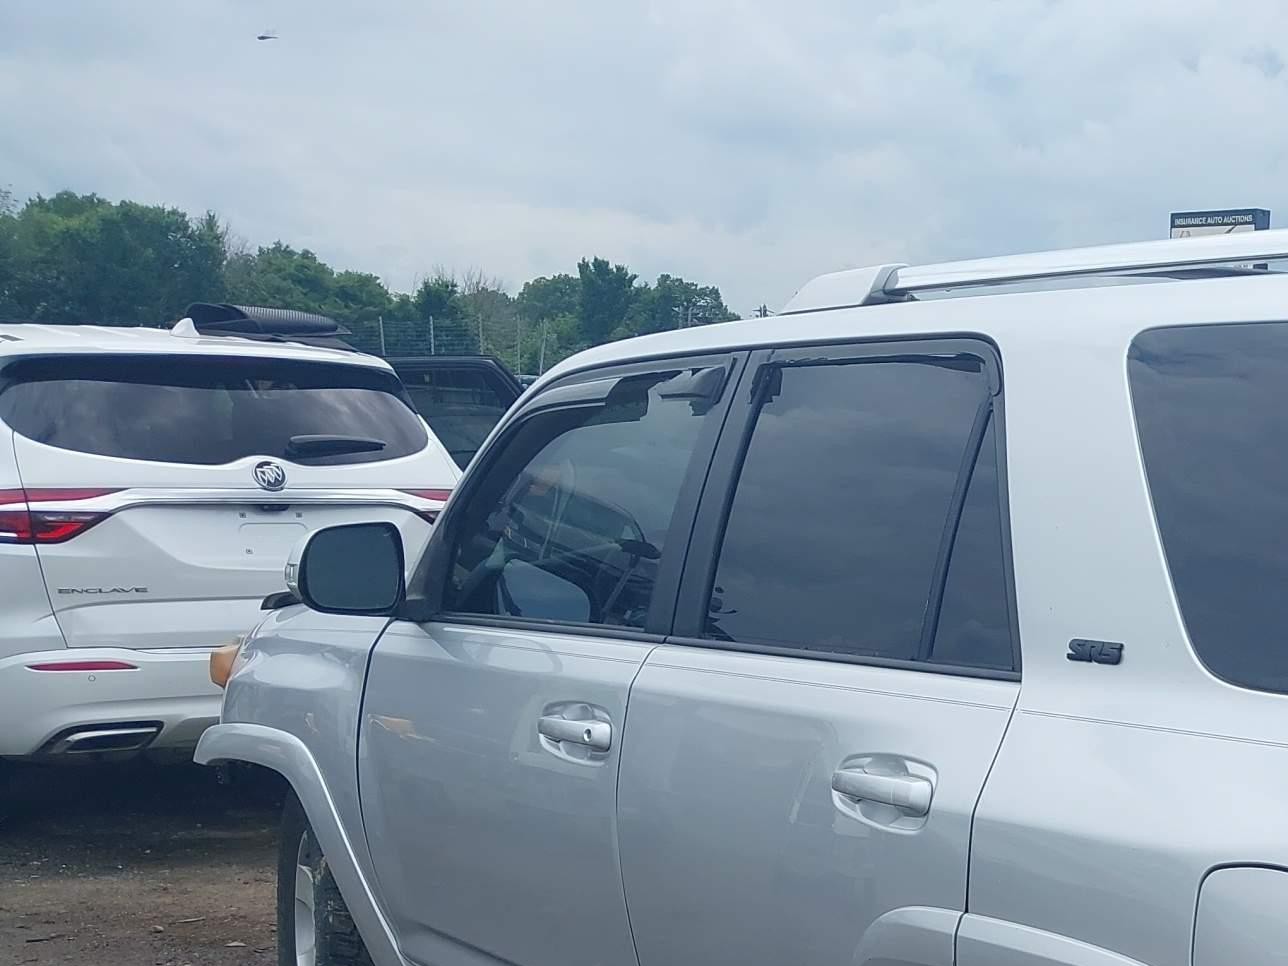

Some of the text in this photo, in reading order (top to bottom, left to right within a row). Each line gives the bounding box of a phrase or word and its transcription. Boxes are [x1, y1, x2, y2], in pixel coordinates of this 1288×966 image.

[1174, 214, 1253, 226] INSURANCE AUTO AUCTIONS
[1066, 638, 1124, 666] SR5
